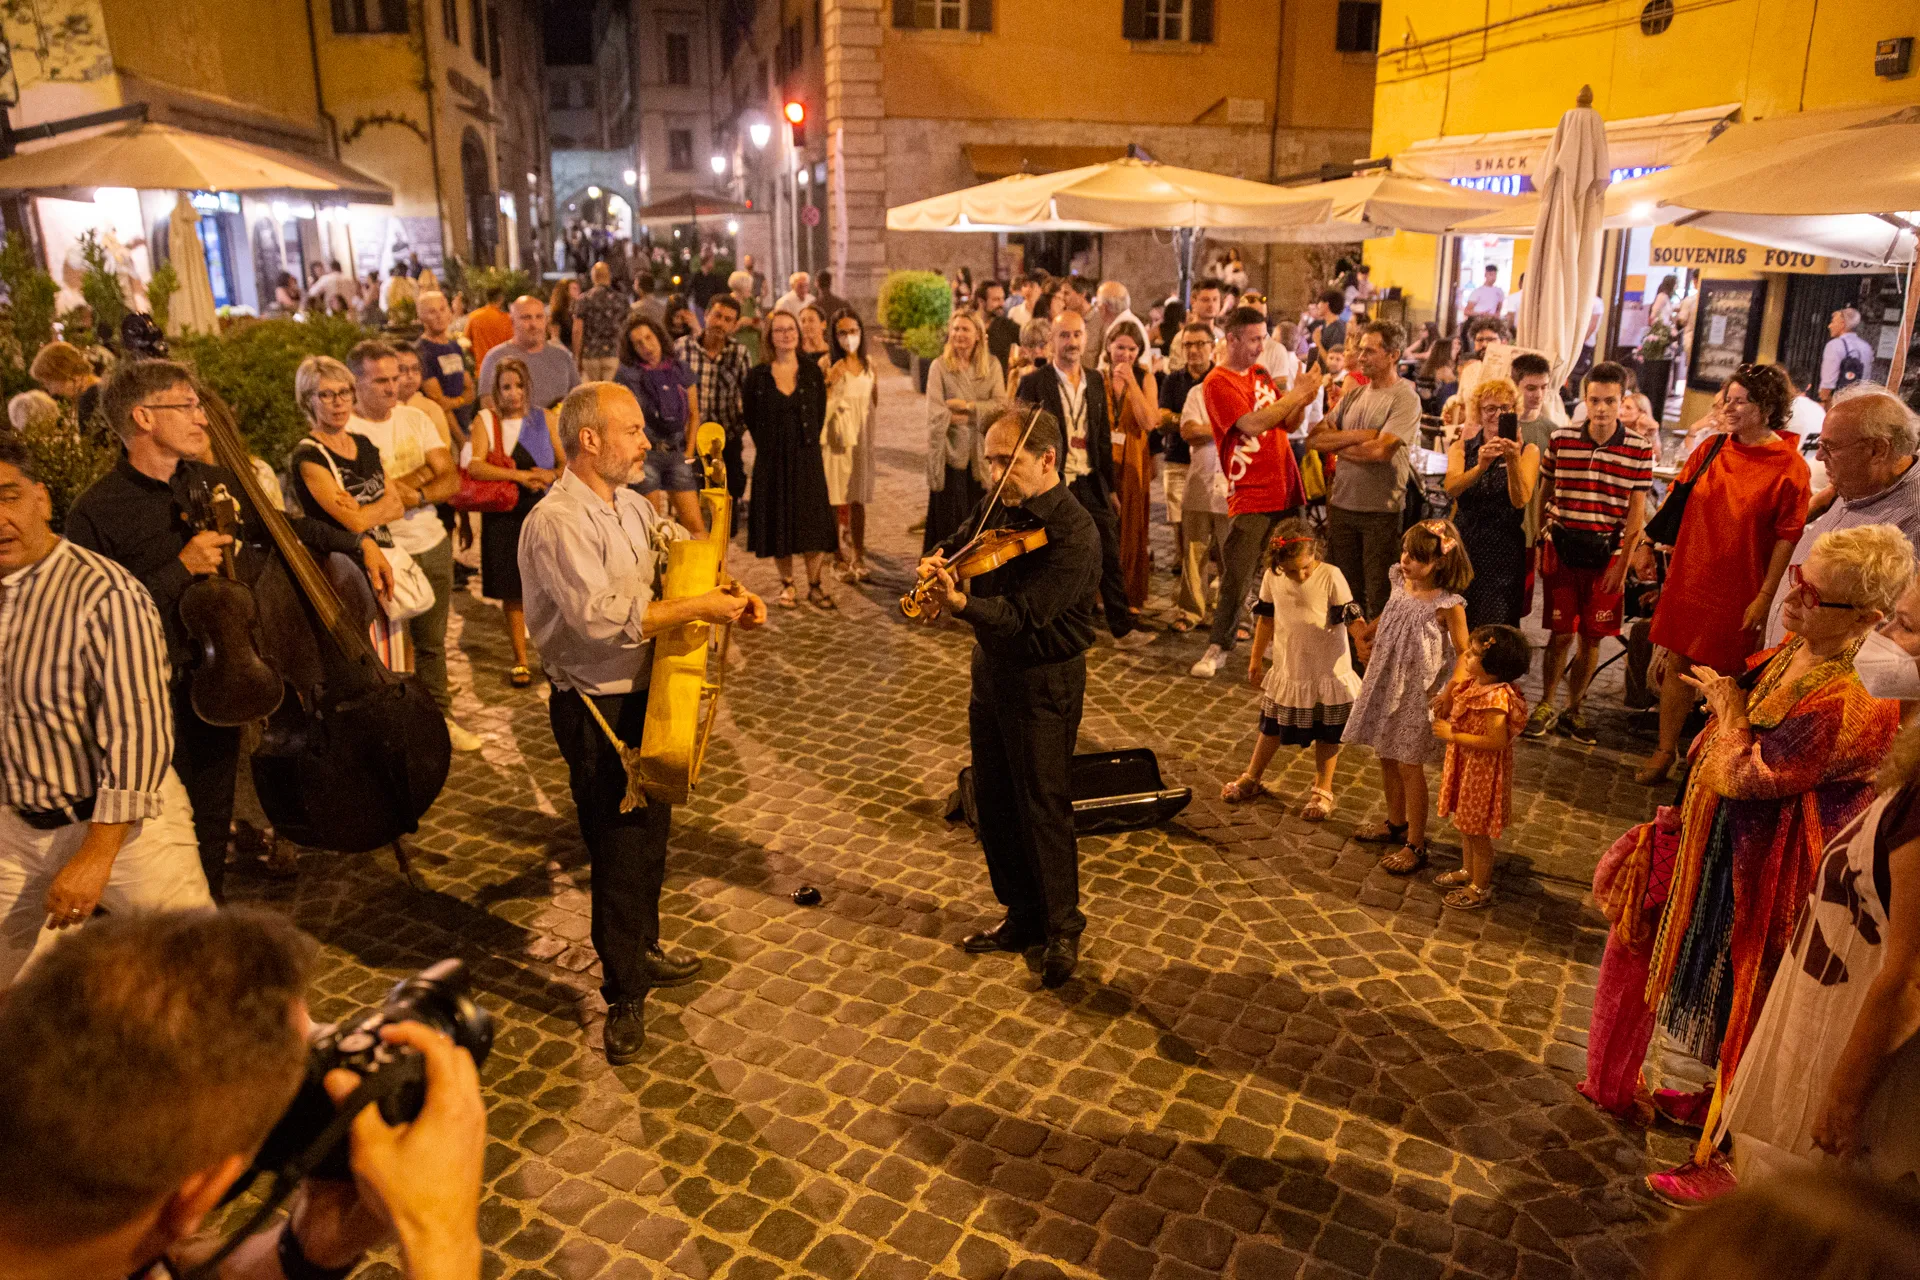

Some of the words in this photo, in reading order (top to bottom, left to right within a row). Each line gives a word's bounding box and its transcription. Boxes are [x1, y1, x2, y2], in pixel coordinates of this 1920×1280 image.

[1475, 155, 1528, 171] SNACK
[1654, 247, 1747, 265] SOUVENIRS
[1764, 249, 1816, 267] FOTO
